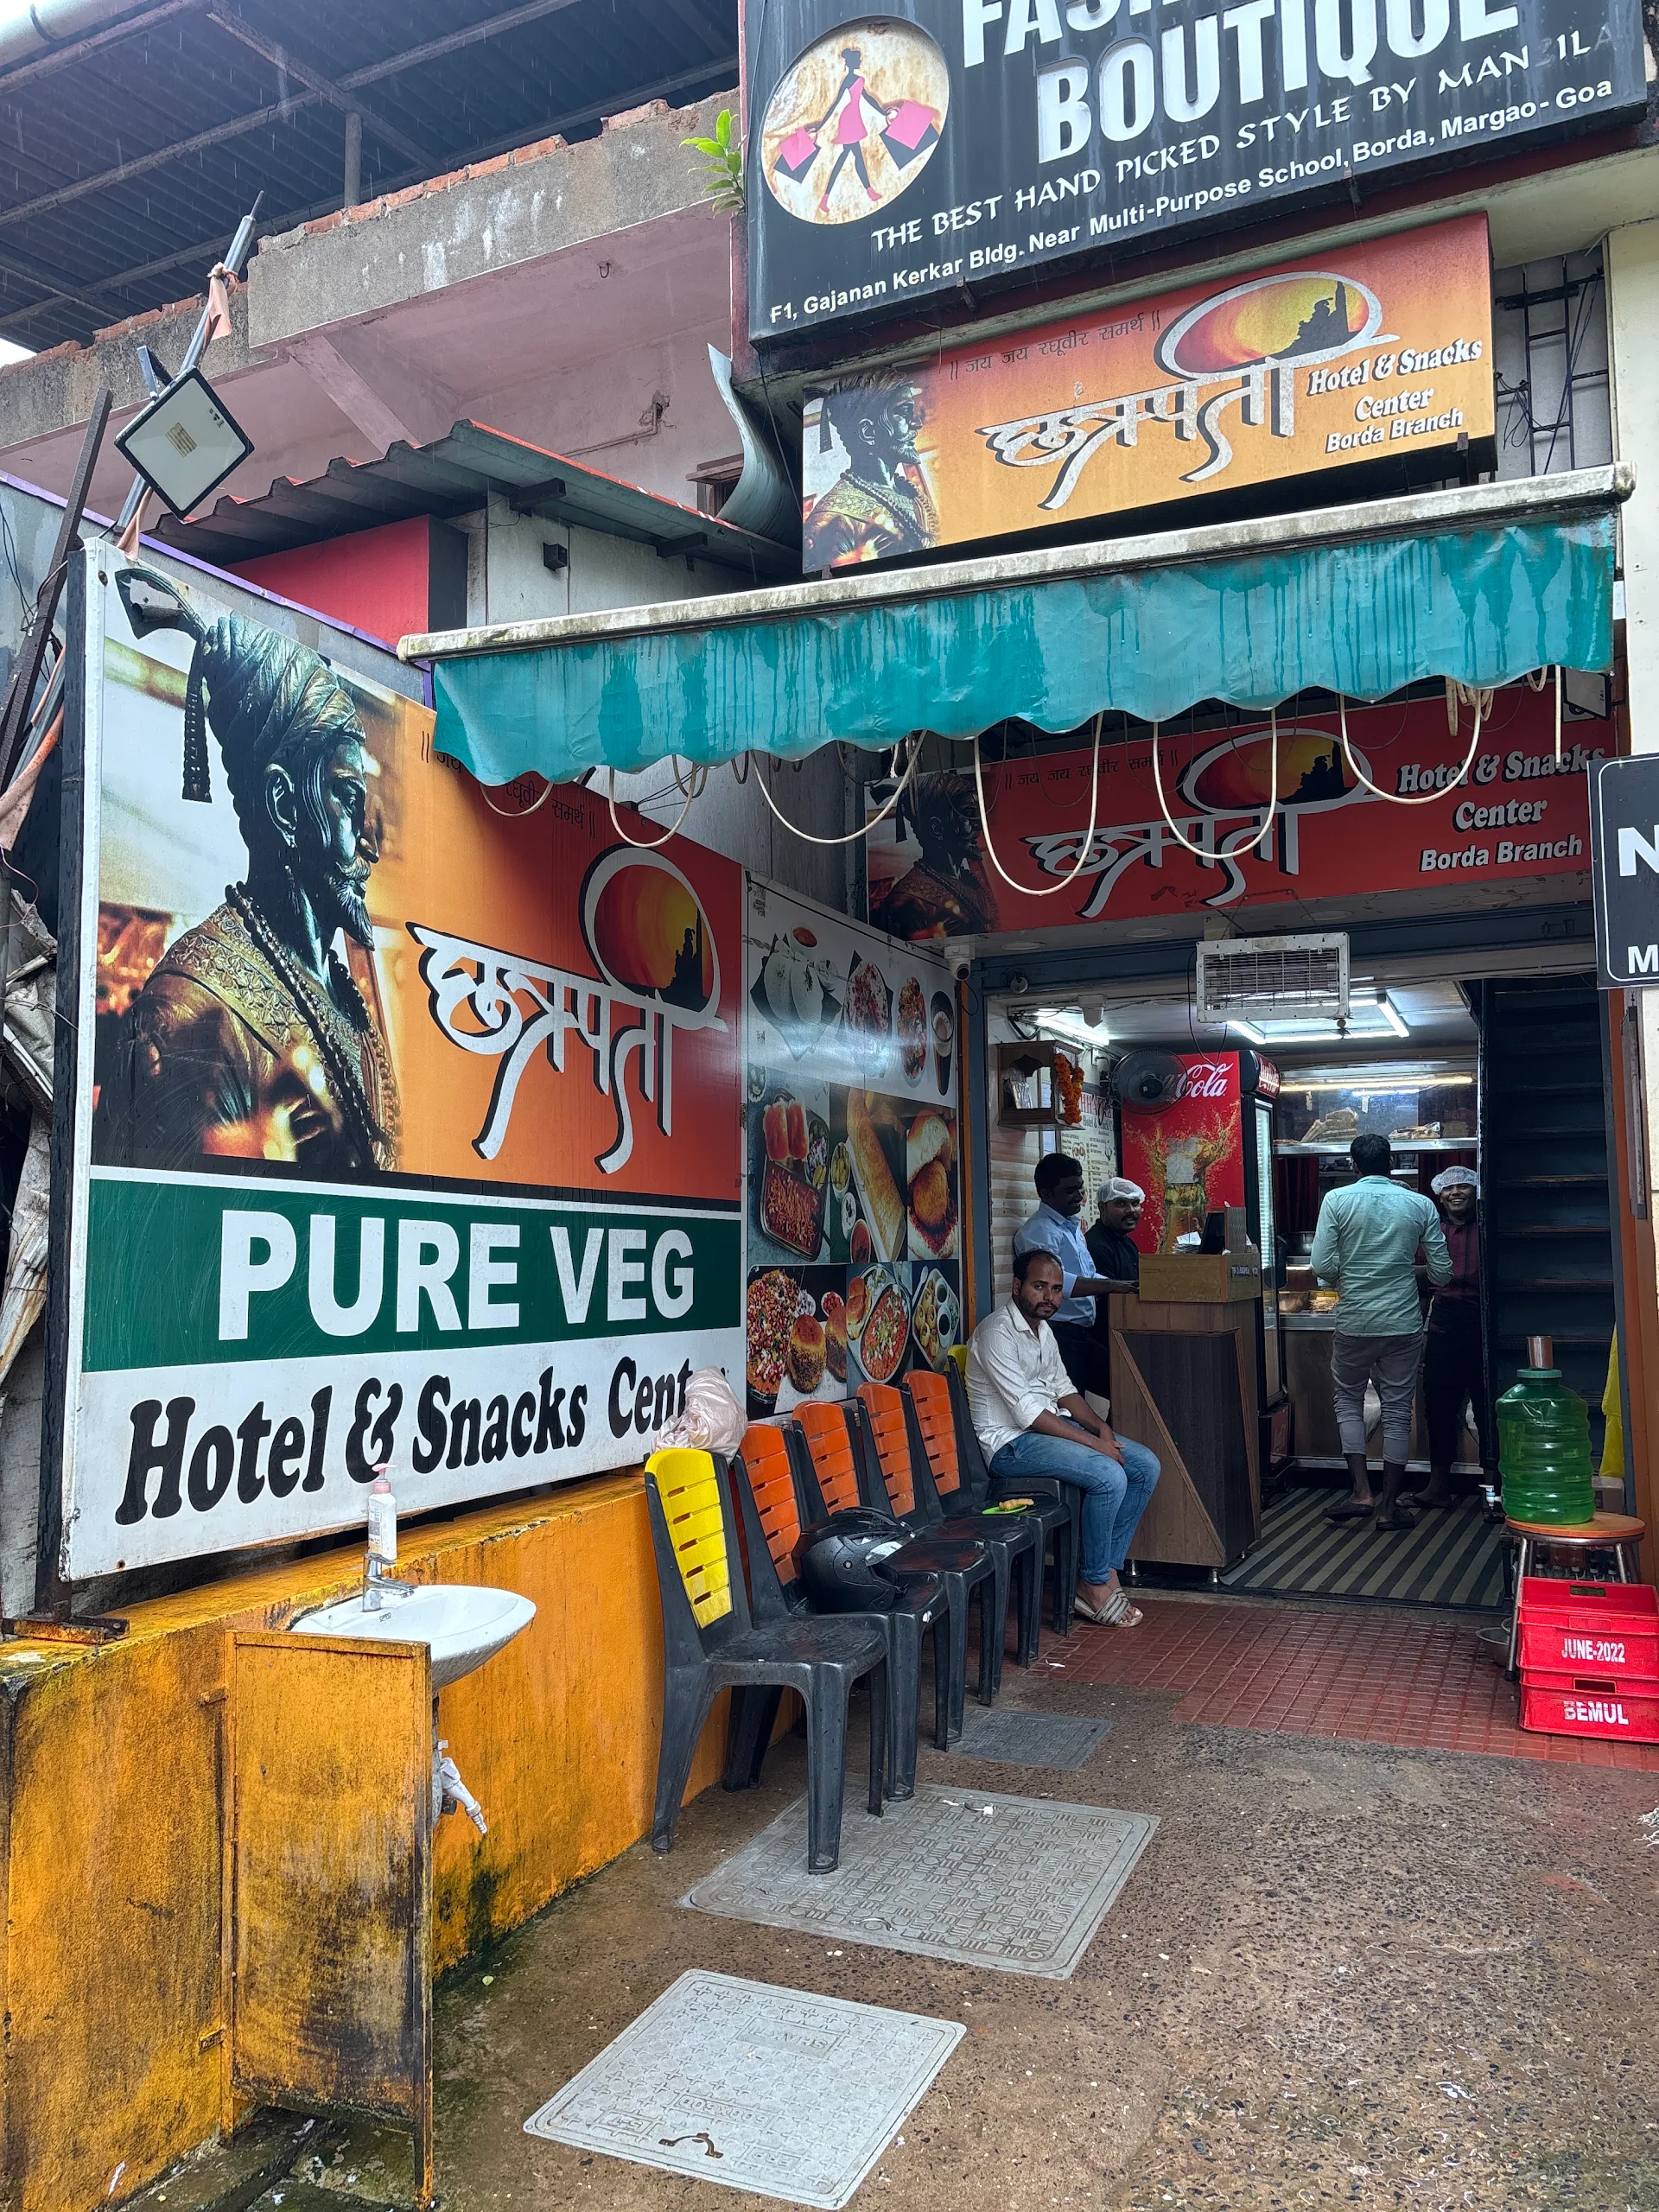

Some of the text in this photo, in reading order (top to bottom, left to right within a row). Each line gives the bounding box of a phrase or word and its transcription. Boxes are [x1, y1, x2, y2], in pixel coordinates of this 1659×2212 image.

[872, 219, 923, 252] THE
[932, 195, 1002, 236] BEST
[1014, 169, 1101, 213] HAND
[1116, 134, 1221, 183] PICKED
[1236, 96, 1352, 149] STYLE
[1370, 77, 1417, 113] BY
[804, 279, 887, 315] Gajanan
[893, 258, 964, 291] Kerkar
[969, 243, 1025, 270] Bldg.
[1029, 226, 1081, 254] Near
[1089, 177, 1252, 236] Multi-Purpose
[1258, 150, 1350, 188] School,
[1352, 127, 1435, 162] Borda,
[965, 354, 992, 373] जय
[1001, 347, 1028, 365] जय
[1098, 313, 1145, 340] समर्थ
[1307, 338, 1484, 397] Hotel & Snacks
[1355, 388, 1434, 422] Center
[1325, 408, 1464, 453] Borda Branch
[1047, 767, 1071, 781] जय
[1395, 758, 1469, 796] Hotel
[1472, 754, 1500, 785] &
[551, 798, 584, 830] समर्थ
[1452, 799, 1548, 833] Center
[1419, 834, 1582, 872] Borda Branch
[218, 1210, 696, 1341] PURE VEG
[114, 1355, 694, 1527] Hotel & Snacks Cent
[1561, 1637, 1626, 1663] JUNE-2022
